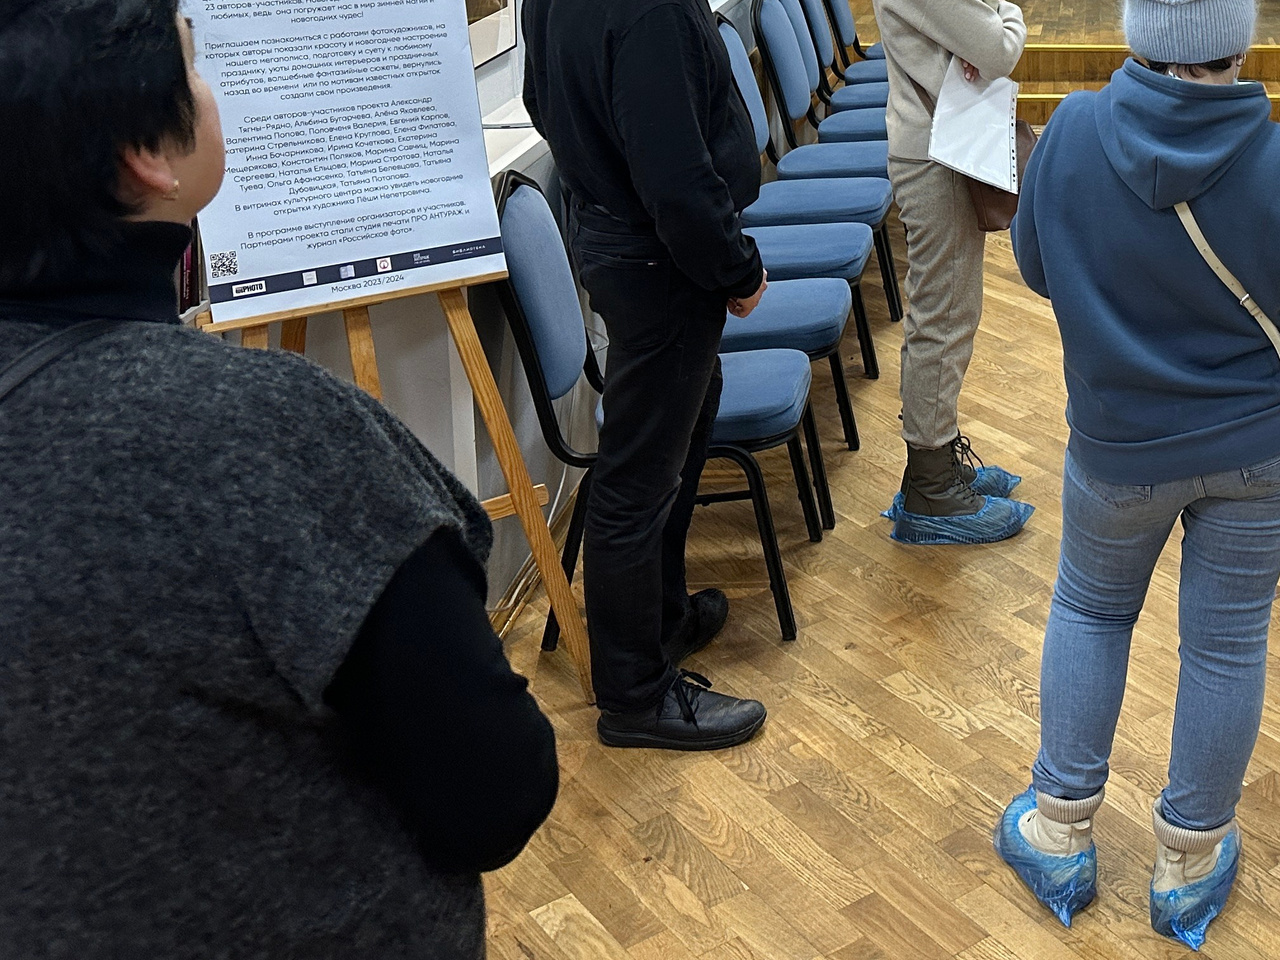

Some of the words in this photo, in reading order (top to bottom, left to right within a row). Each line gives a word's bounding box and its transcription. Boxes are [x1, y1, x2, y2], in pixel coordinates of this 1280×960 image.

[204, 3, 215, 11] 23
[290, 14, 337, 23] новогодних
[338, 10, 363, 20] чудес!
[293, 4, 335, 14] погружает
[204, 40, 259, 50] Приглашаем
[261, 34, 321, 44] познакомиться
[329, 30, 369, 39] работами
[205, 50, 241, 59] которых
[241, 47, 272, 56] авторы
[273, 44, 312, 53] показали
[314, 41, 347, 50] красоту
[354, 36, 401, 46] новогоднее
[402, 32, 447, 41] настроение
[225, 58, 258, 67] нашего
[312, 49, 356, 59] подготовку
[364, 46, 386, 54] суету
[393, 42, 432, 51] любимому
[268, 65, 290, 74] уюты
[291, 61, 333, 71] домашних
[334, 56, 380, 66] интерьеров
[388, 51, 438, 61] праздничных
[263, 83, 299, 93] времени
[330, 76, 364, 85] мотивам
[365, 72, 404, 81] известных
[405, 68, 440, 77] открыток
[267, 72, 314, 82] волшебные
[315, 67, 368, 78] фантазийные
[402, 60, 442, 68] вернулись
[280, 91, 314, 100] создали
[243, 115, 272, 123] Среди
[272, 105, 355, 120] авторов-участников
[356, 101, 389, 110] проекта
[390, 96, 432, 106] Александр
[225, 134, 272, 144] Валентина
[389, 115, 419, 124] Евгений
[294, 117, 328, 127] Альбина
[225, 144, 266, 154] катерина
[245, 152, 268, 162] Инна
[326, 142, 353, 151] Ирина
[397, 132, 437, 142] Екатерина
[281, 155, 328, 166] Константин
[364, 146, 396, 156] Марина
[429, 138, 459, 147] Марина
[266, 179, 292, 187] Ольга
[347, 167, 377, 176] Татьяна
[422, 157, 451, 166] Татьяна
[278, 166, 312, 176] Наталья
[349, 157, 382, 167] Марина
[422, 148, 453, 157] Наталья
[242, 200, 282, 210] витринах
[283, 192, 332, 205] культурного
[333, 188, 362, 198] центра
[363, 184, 389, 192] можно
[389, 180, 419, 190] увидеть
[420, 174, 463, 184] новогодние
[339, 177, 370, 186] Татьяна
[273, 205, 311, 215] открытки
[312, 198, 355, 210] художника
[240, 236, 293, 250] Партнерами
[294, 230, 329, 242] проекта
[330, 226, 354, 235] стали
[354, 222, 381, 232] студия
[382, 218, 410, 227] печати
[410, 213, 428, 222] ПРО
[429, 208, 463, 220] АНТУРАЖ
[255, 225, 302, 238] программе
[303, 217, 355, 230] выступление
[356, 208, 416, 222] организаторов
[306, 239, 337, 249] журнал
[331, 283, 362, 293] Москва
[363, 274, 404, 288] 2023/2024
